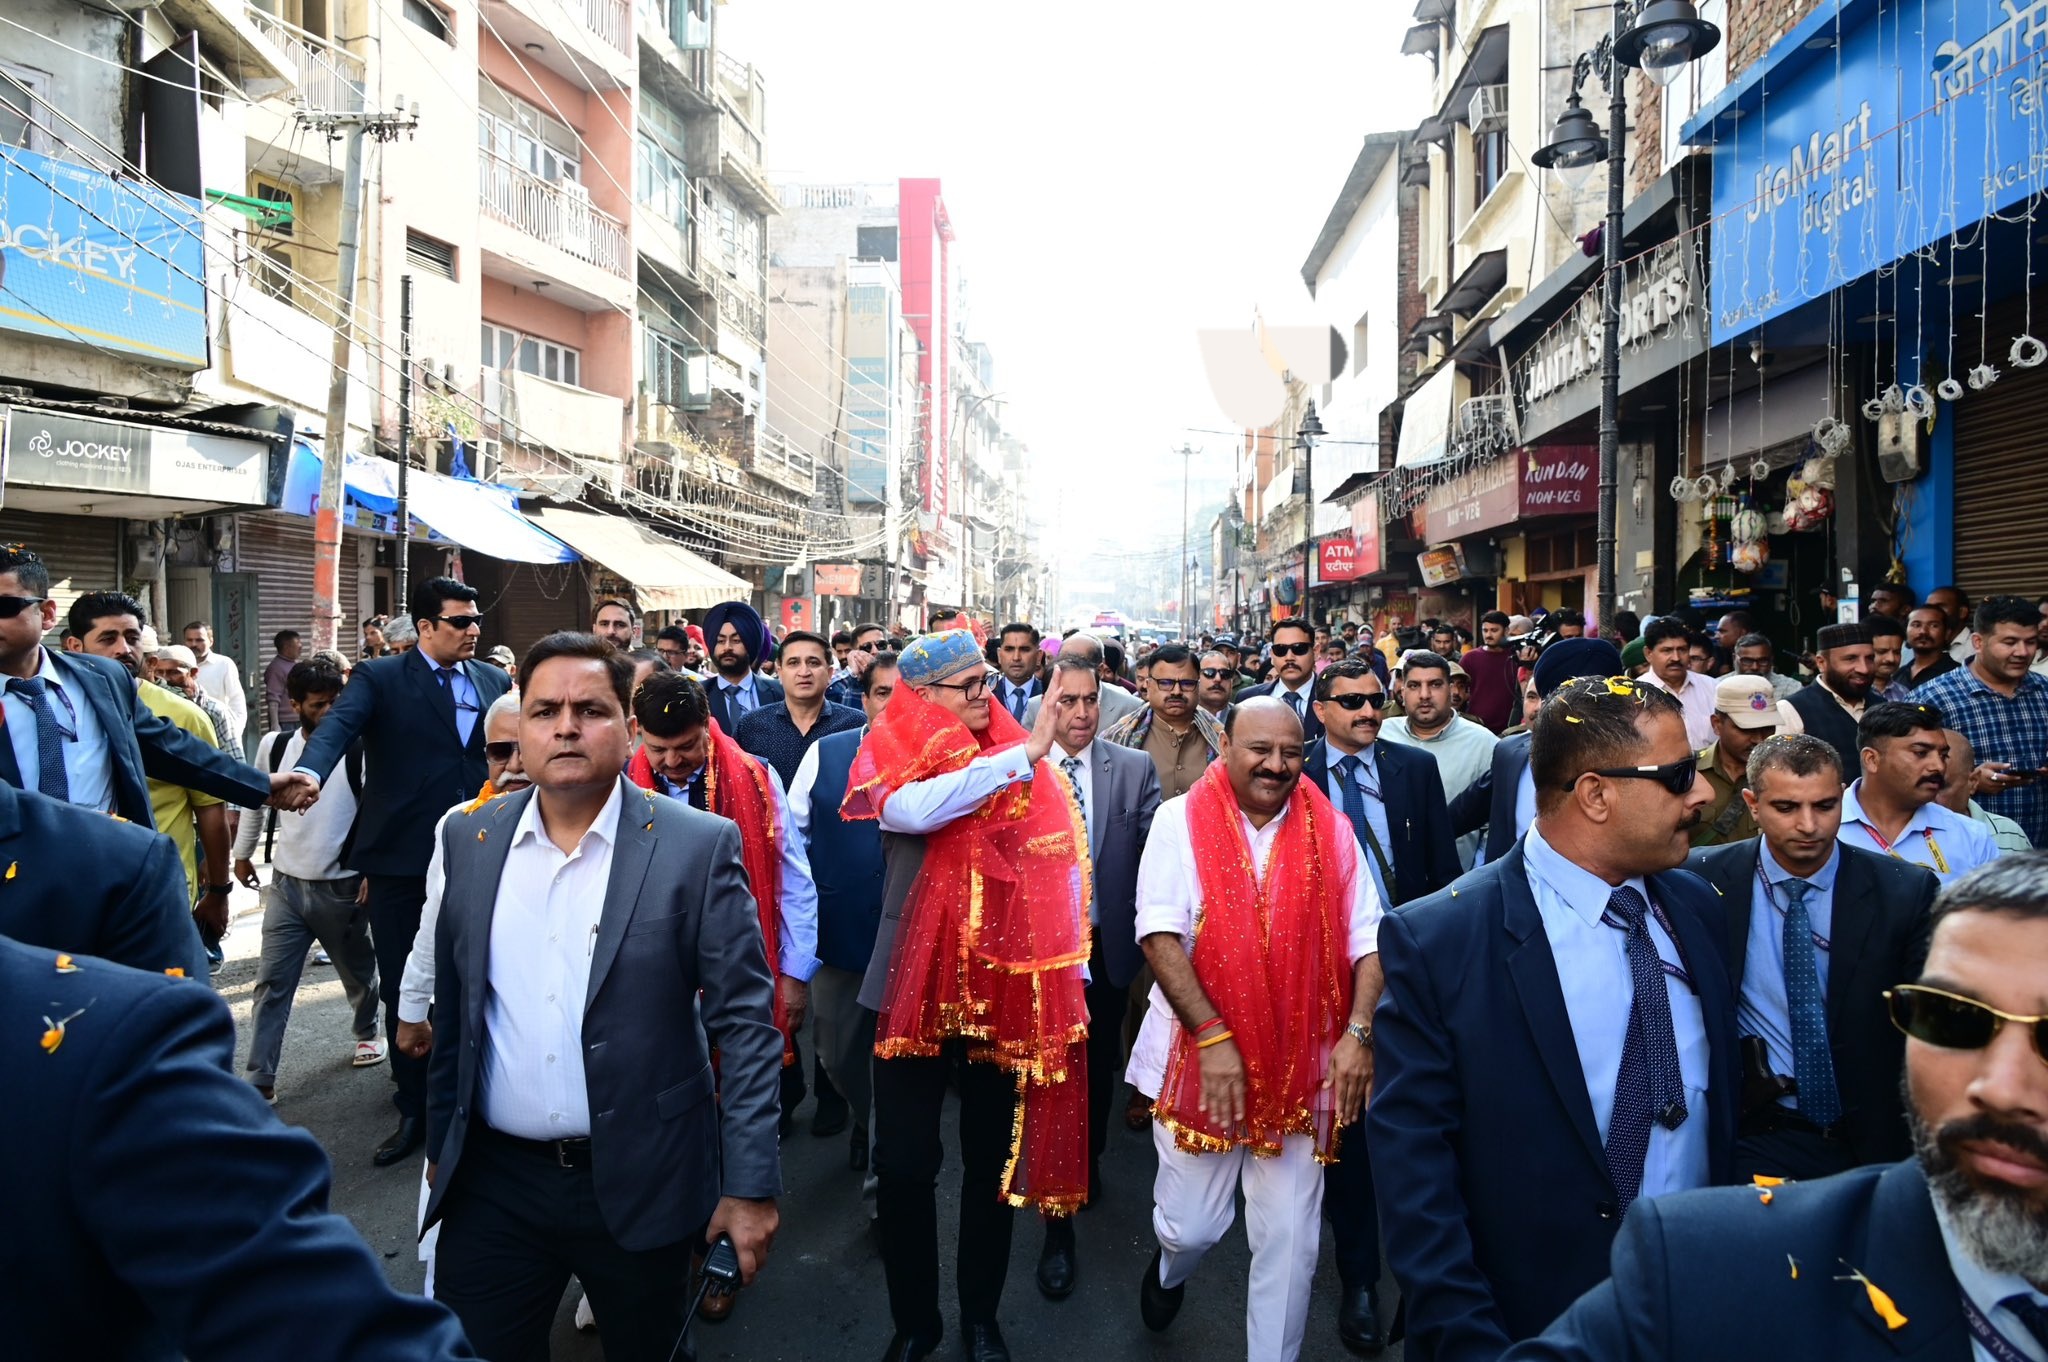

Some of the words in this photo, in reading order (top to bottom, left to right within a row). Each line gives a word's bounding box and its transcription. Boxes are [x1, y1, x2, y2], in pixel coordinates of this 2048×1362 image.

[1746, 100, 1872, 224] JioMart
[1802, 157, 1874, 235] digital
[850, 301, 883, 314] OPTICS
[1526, 335, 1584, 402] JANTA
[1588, 266, 1684, 363] SORTS
[57, 440, 132, 462] JOCKEY
[176, 460, 196, 469] OJAS
[1525, 461, 1589, 483] KUNDAN
[1526, 489, 1581, 505] NON-VEG
